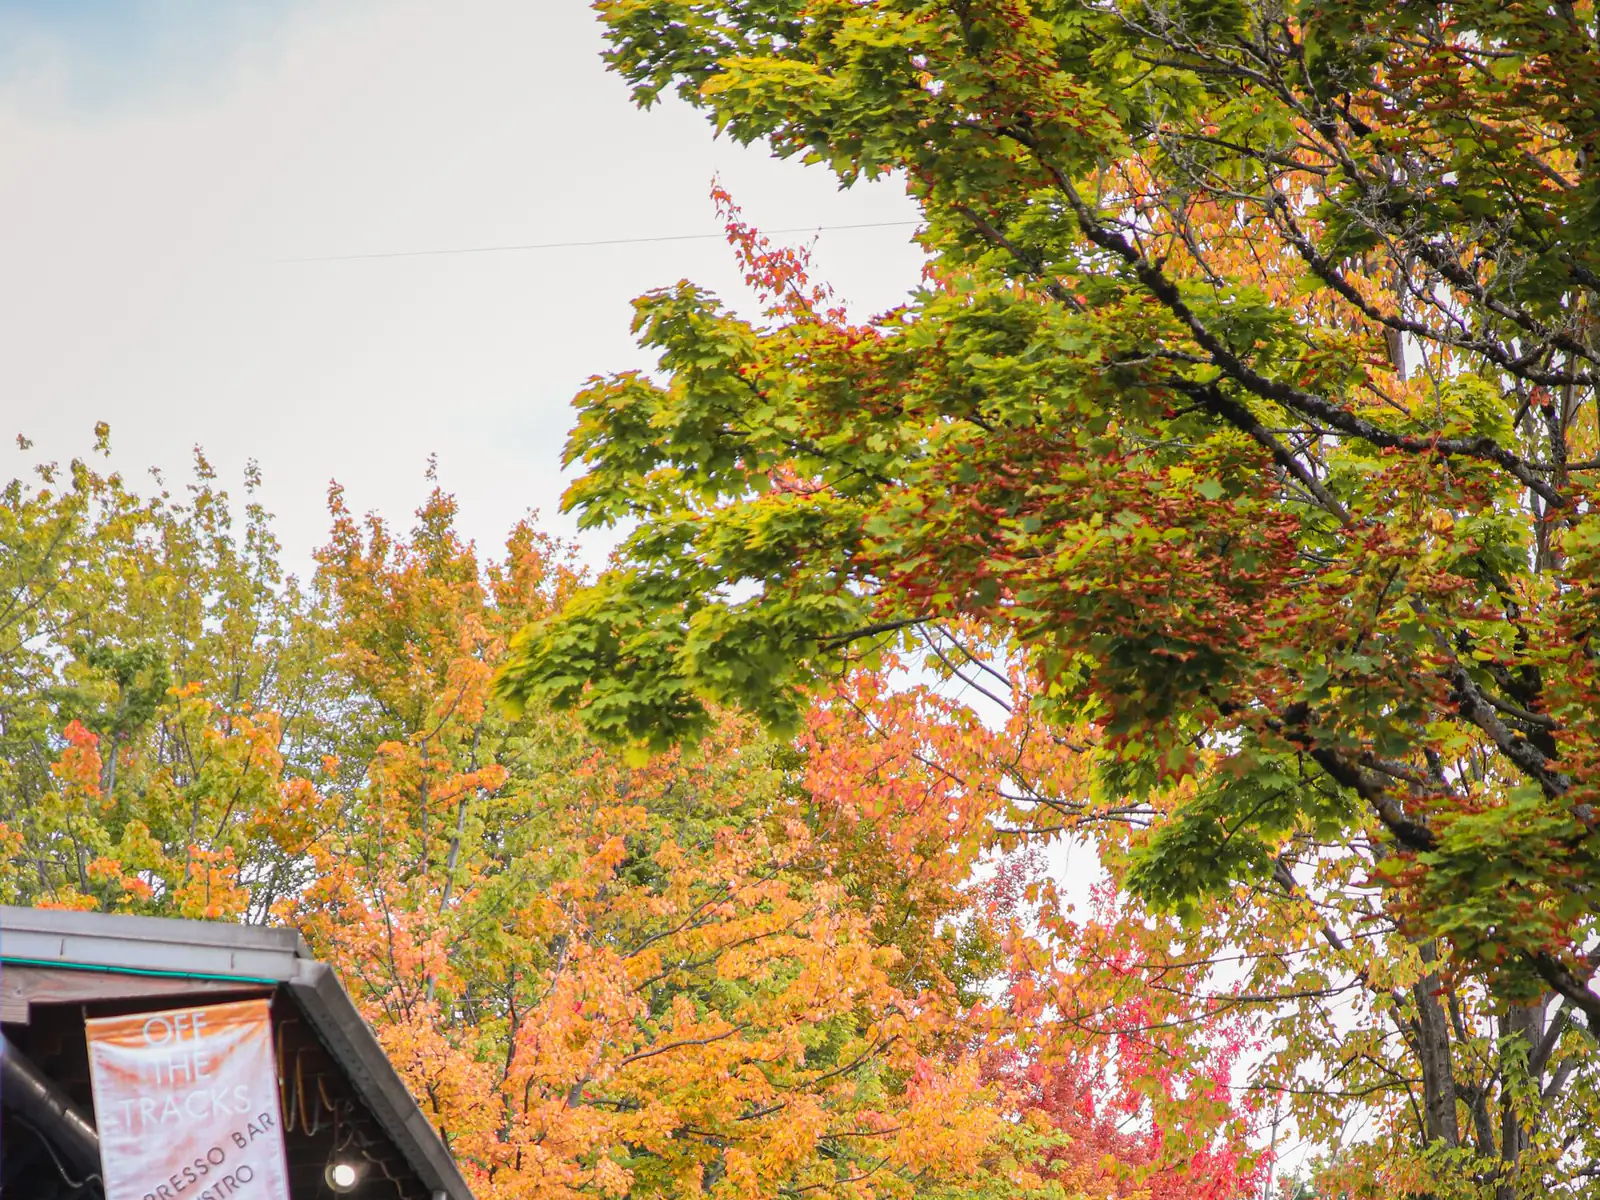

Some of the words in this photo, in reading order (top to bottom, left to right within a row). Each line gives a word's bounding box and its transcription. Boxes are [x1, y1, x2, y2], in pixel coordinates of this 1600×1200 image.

[142, 1011, 207, 1045] OFF
[153, 1050, 211, 1084] THE
[118, 1084, 251, 1128] TRACKS
[231, 1112, 275, 1149] BAR
